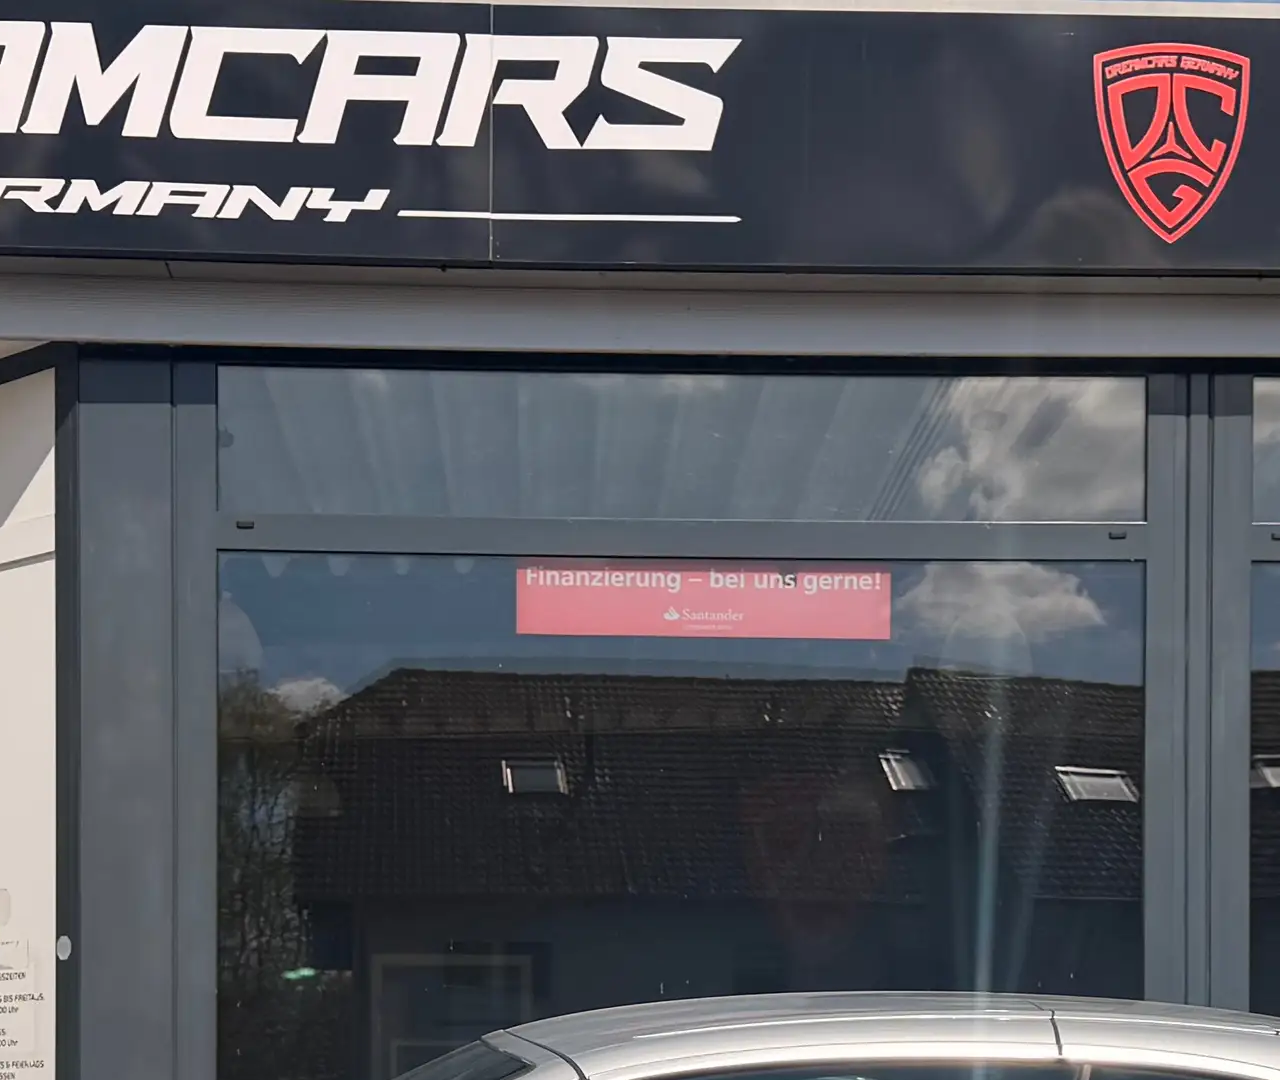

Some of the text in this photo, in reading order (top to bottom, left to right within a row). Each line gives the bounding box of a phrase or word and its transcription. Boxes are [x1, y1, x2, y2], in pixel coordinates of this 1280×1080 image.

[526, 567, 681, 593] Finanzierung
[709, 569, 744, 589] bei
[754, 573, 796, 589] uns
[803, 572, 881, 594] gerne!
[681, 608, 743, 621] Santander
